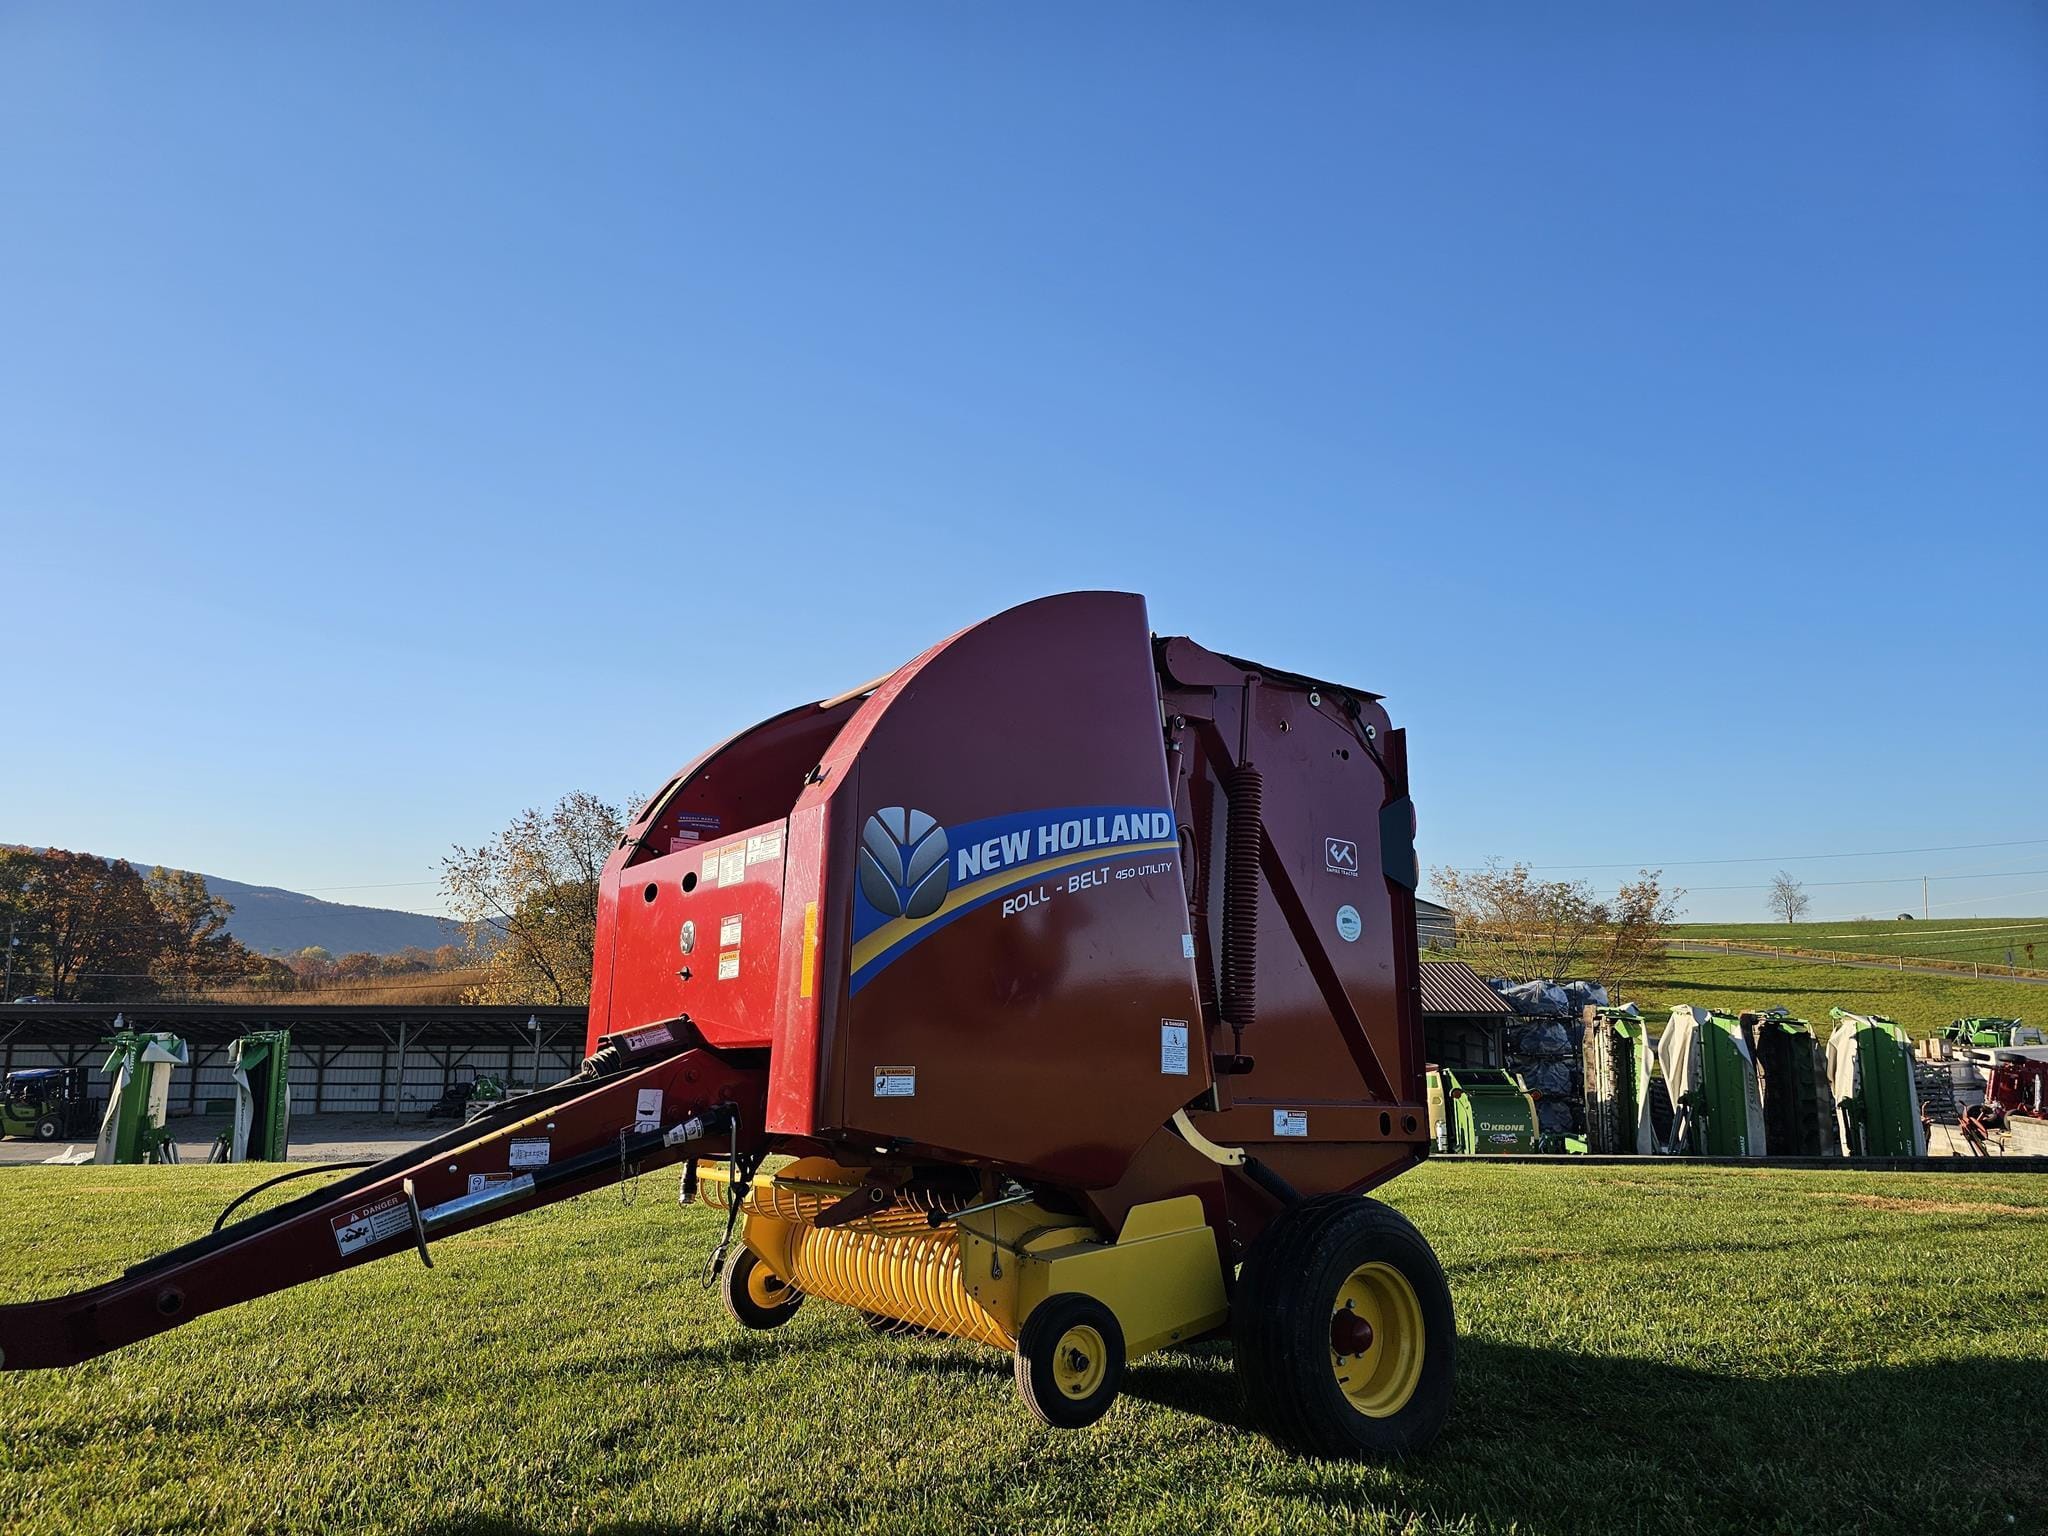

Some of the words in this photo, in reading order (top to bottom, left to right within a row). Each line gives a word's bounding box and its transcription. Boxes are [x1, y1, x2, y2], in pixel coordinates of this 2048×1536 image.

[957, 829, 1031, 881] NEW
[1038, 812, 1171, 856] HOLLAND
[1002, 886, 1051, 918] ROLL
[1068, 867, 1110, 893] BELT
[1115, 868, 1136, 880] 450
[1138, 862, 1173, 876] UTILITY
[363, 1197, 399, 1217] DANGER
